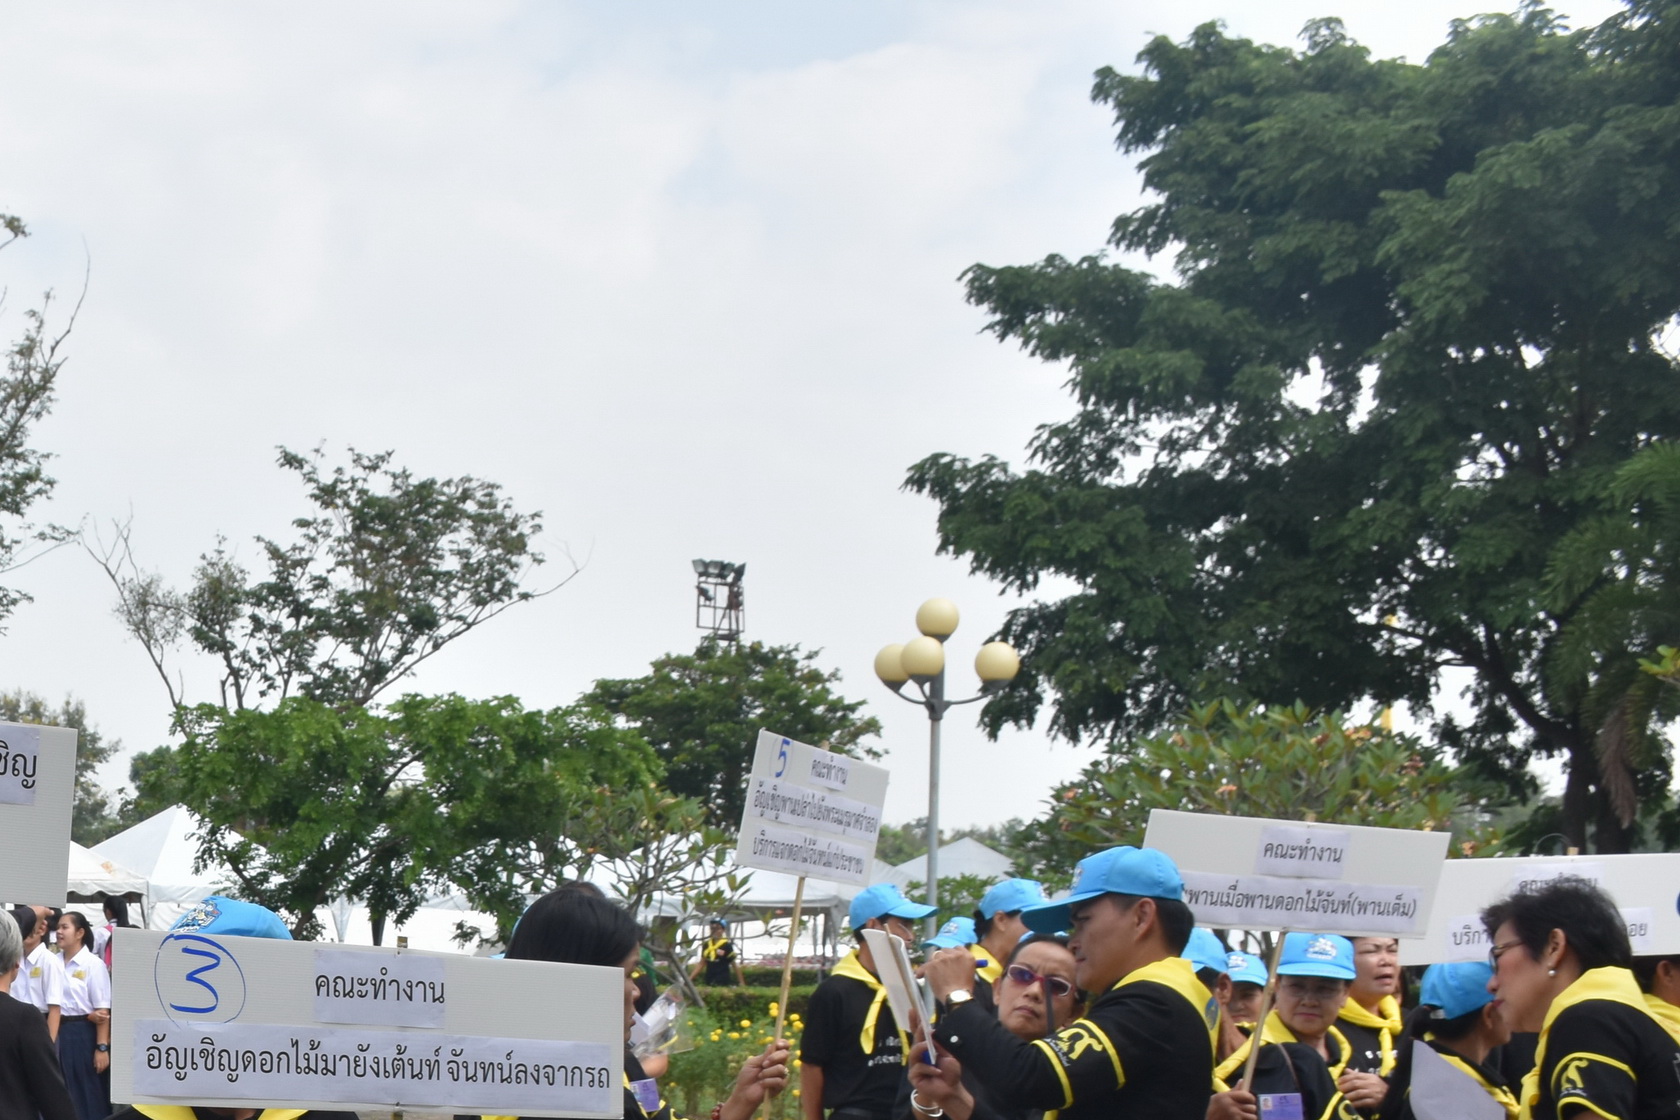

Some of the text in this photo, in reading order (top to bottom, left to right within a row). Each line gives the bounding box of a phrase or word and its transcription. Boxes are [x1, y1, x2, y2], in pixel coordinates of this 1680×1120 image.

[775, 738, 790, 778] 5
[1263, 841, 1344, 863] คณะทำงาน
[1185, 880, 1417, 919] พานเมื่อพานดอกไม้จันท์(พานเต็ม)
[170, 946, 221, 1014] 3
[315, 968, 446, 1004] คณะทำงาน
[146, 1034, 610, 1089] อัญเชิญดอกไม้มายังเต้นท์ จันทน์ลงจากรถ
